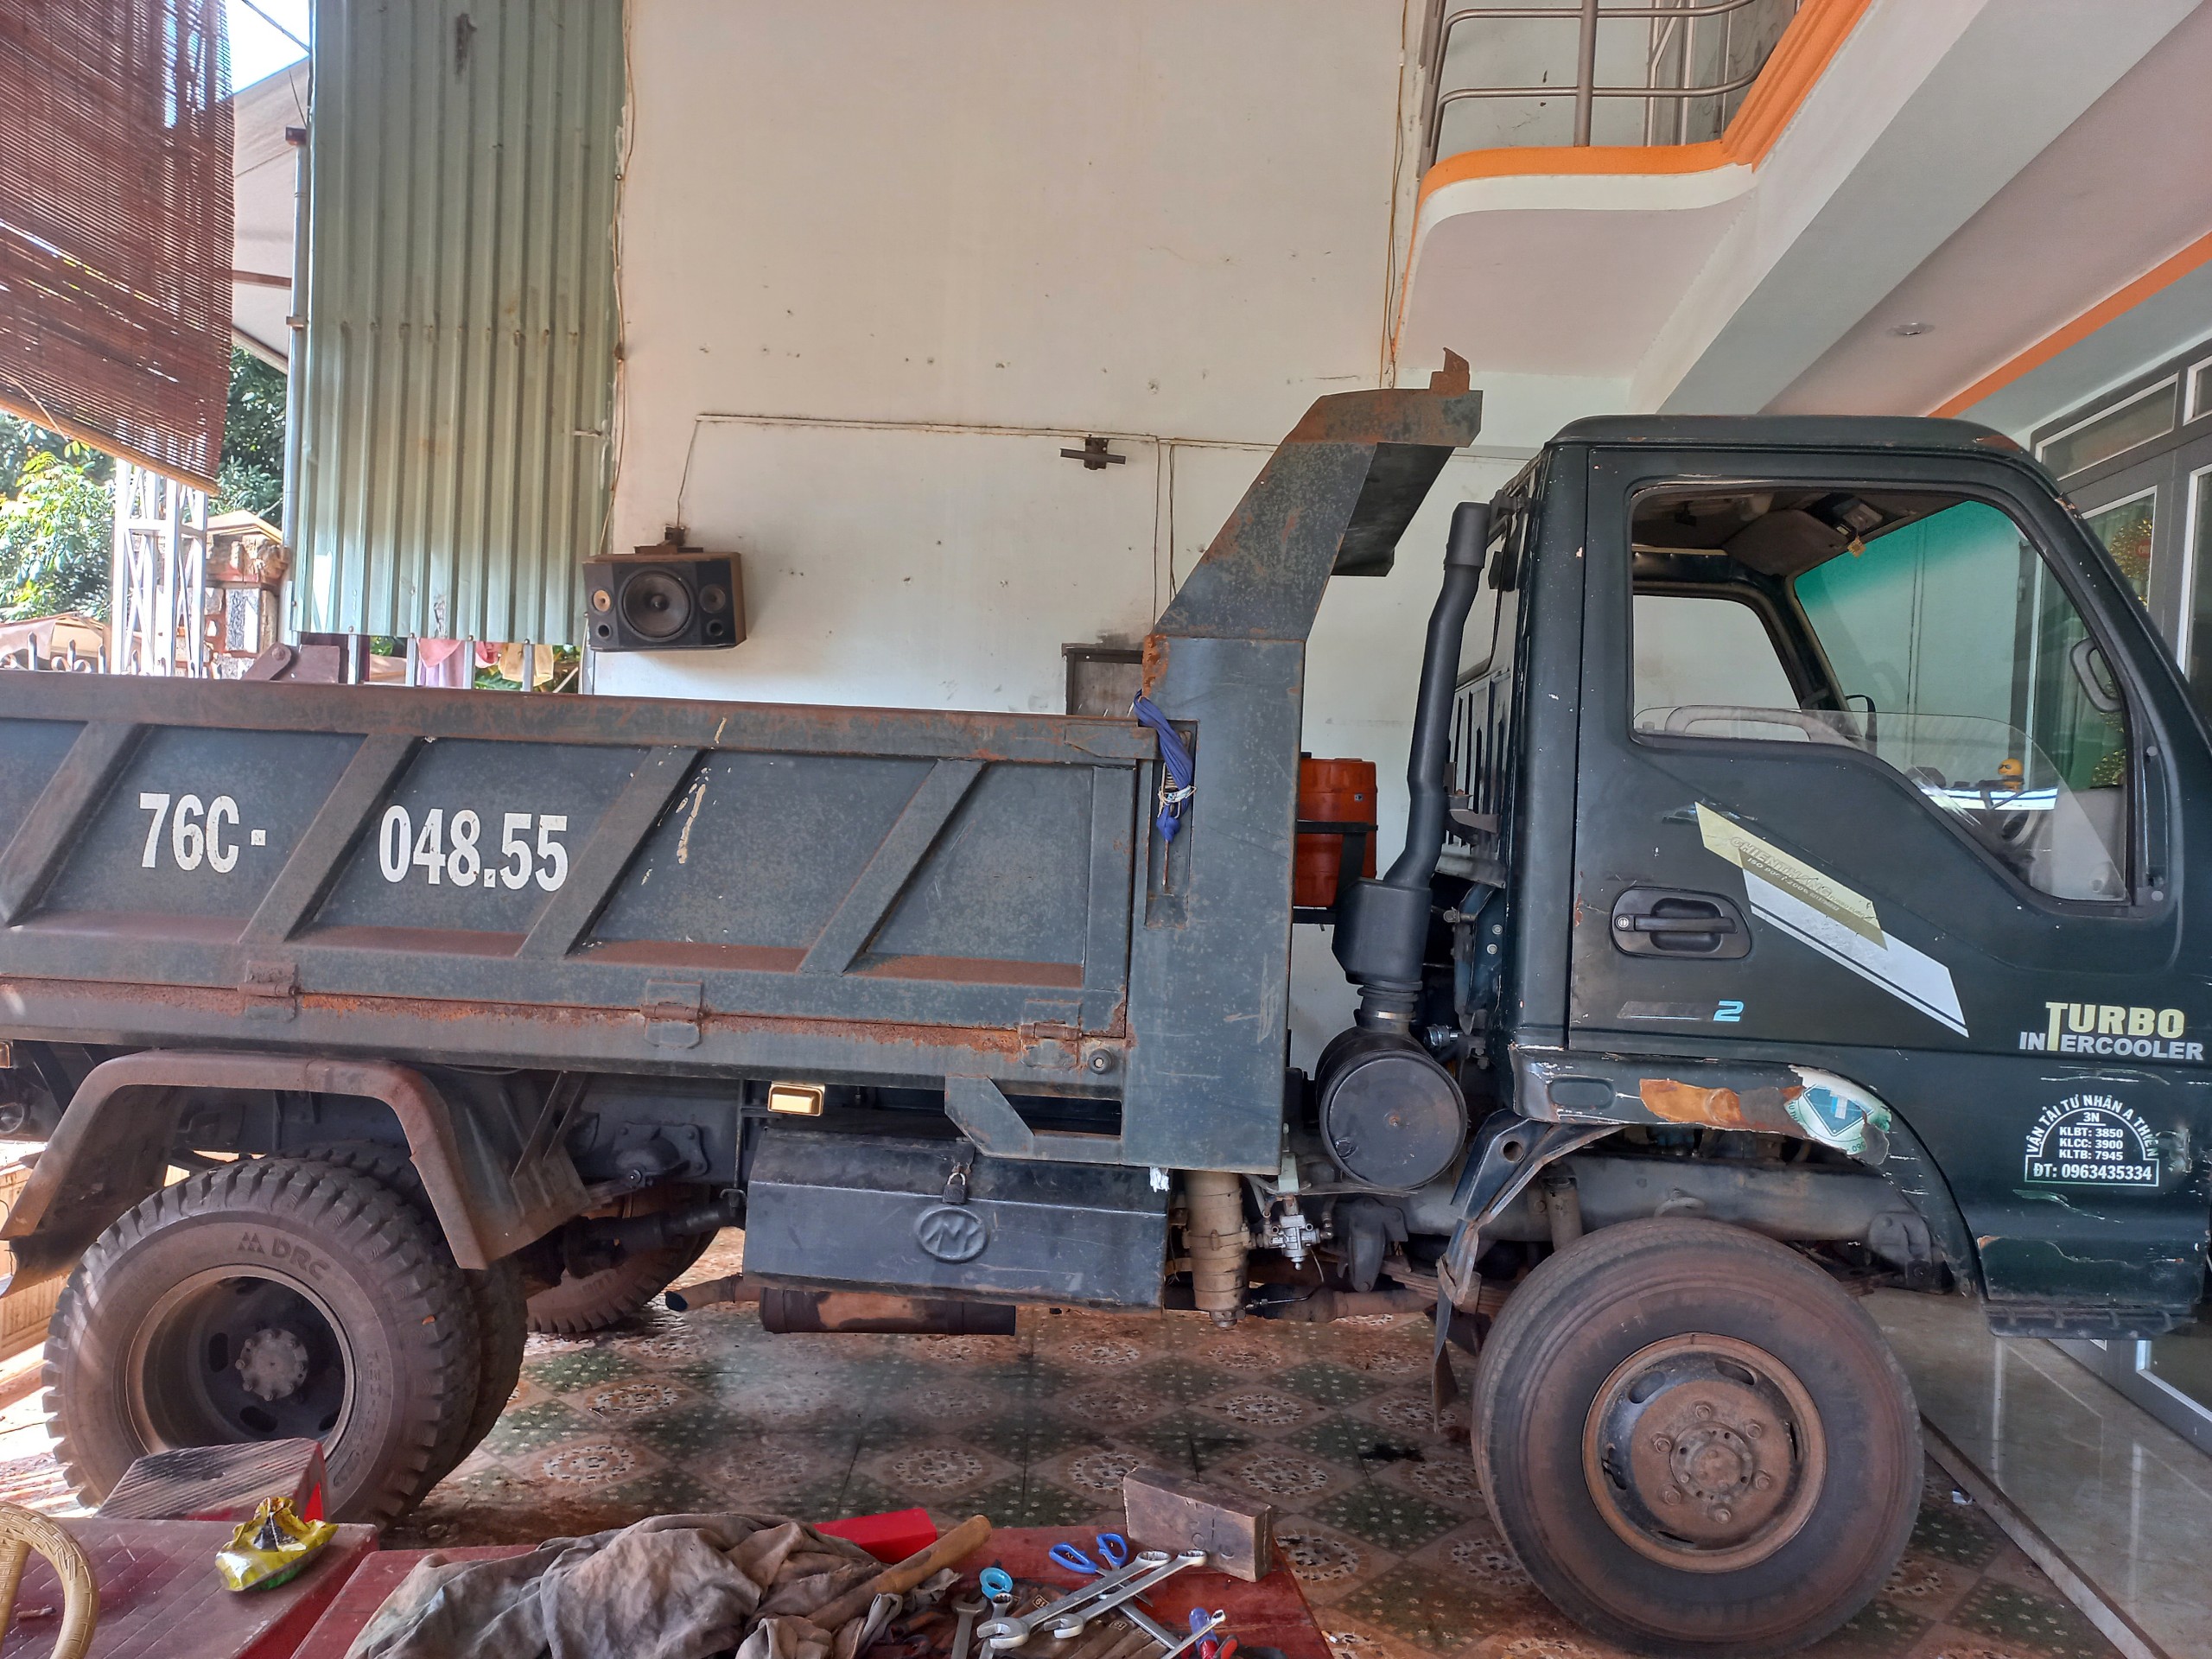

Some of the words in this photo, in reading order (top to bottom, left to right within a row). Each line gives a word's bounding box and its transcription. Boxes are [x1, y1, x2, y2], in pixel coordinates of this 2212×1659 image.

[139, 791, 266, 873] 76C-
[378, 805, 569, 892] 048.55
[1713, 1001, 1744, 1022] 2
[2045, 1001, 2185, 1052] TURBO
[2038, 1105, 2062, 1126] TẢI
[2060, 1094, 2080, 1111] TƯ
[2082, 1094, 2123, 1113] NHÂN
[2122, 1109, 2134, 1120] A
[2082, 1111, 2100, 1122] 3N
[2059, 1127, 2092, 1137] KLBT:
[2094, 1128, 2124, 1138] 3850
[2059, 1138, 2092, 1148] KLCC:
[2094, 1139, 2124, 1150] 3900
[2059, 1149, 2092, 1160] KLTB:
[2094, 1150, 2124, 1160] 7945
[2033, 1163, 2057, 1178] ĐT:
[2062, 1163, 2152, 1180] 0963435334
[271, 1237, 331, 1281] DRC
